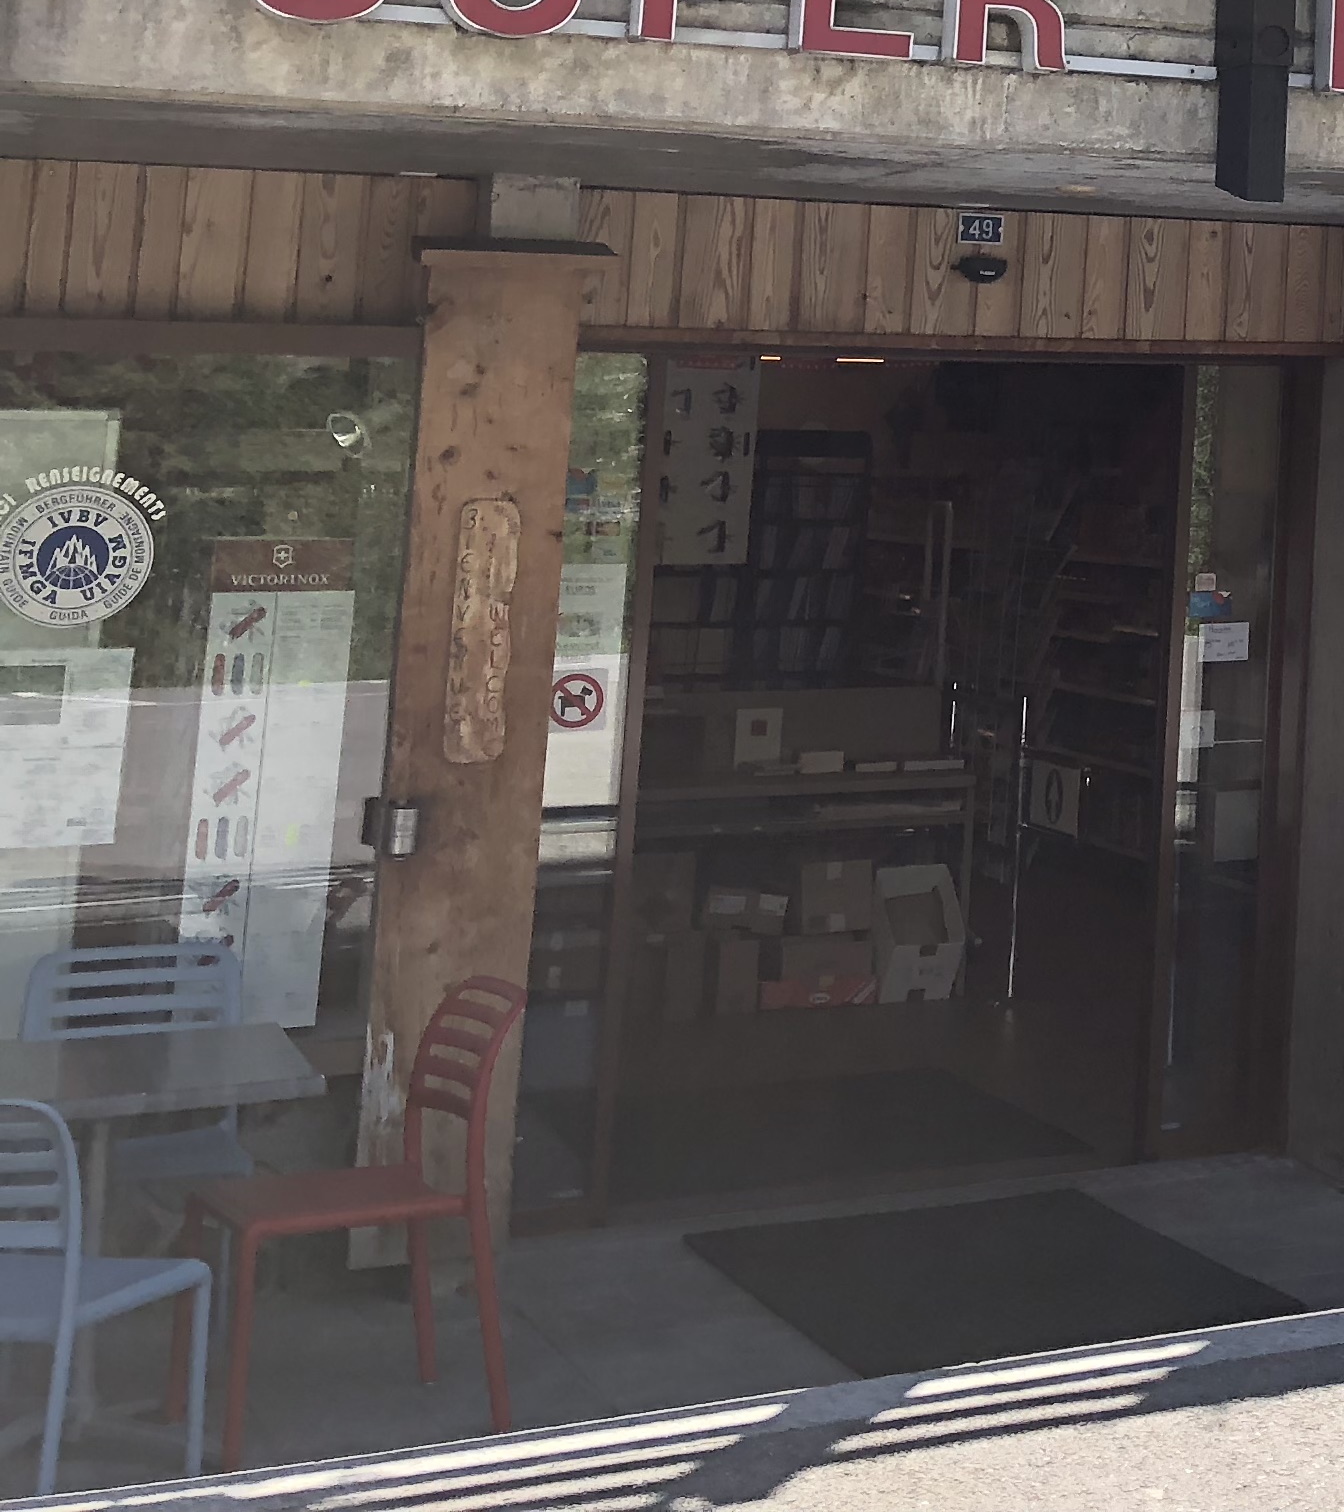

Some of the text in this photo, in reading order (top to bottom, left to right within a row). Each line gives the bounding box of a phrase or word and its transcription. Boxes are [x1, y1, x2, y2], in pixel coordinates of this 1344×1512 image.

[968, 219, 993, 240] 49
[24, 465, 168, 521] RENSEIGNEMENTS
[46, 509, 109, 528] IVBV
[18, 538, 58, 605] IFMGA
[79, 533, 128, 602] UIAGM
[231, 573, 331, 586] VICTORINOX
[49, 609, 89, 622] GUIDA
